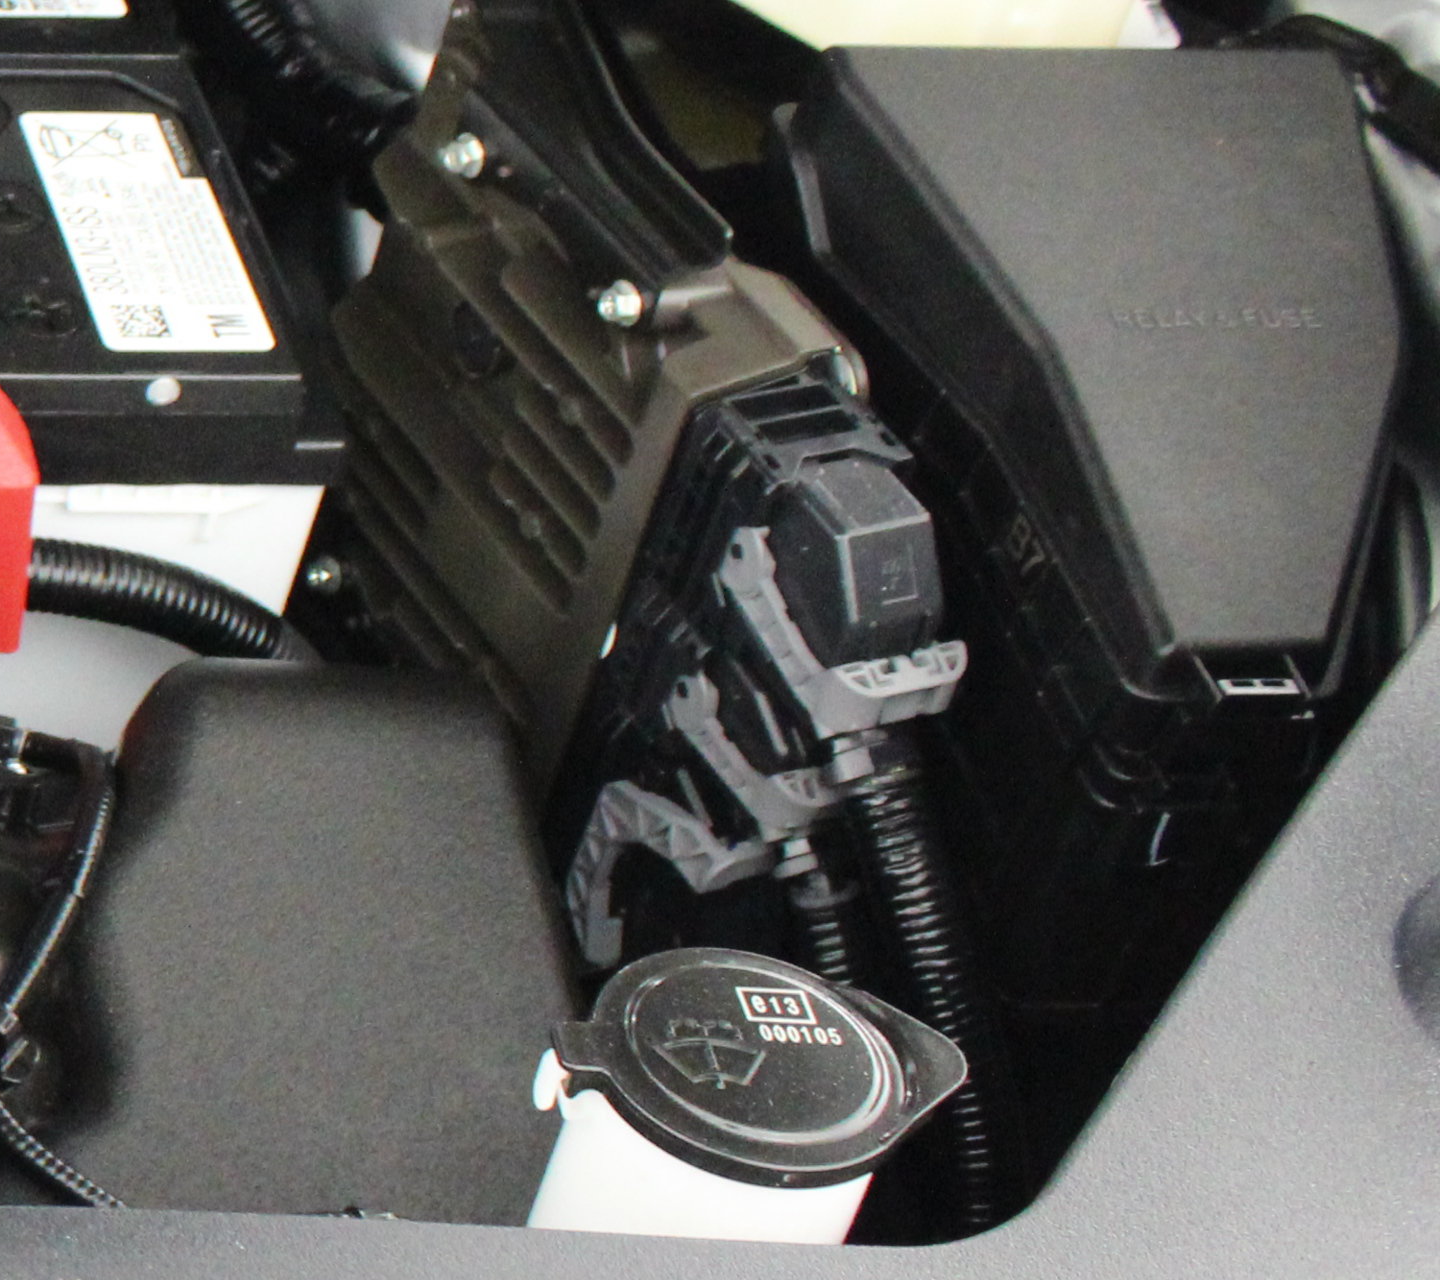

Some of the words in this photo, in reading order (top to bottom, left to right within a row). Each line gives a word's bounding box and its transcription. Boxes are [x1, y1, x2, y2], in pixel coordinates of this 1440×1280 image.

[1242, 307, 1323, 329] FUSE
[749, 993, 802, 1017] e13
[759, 1022, 843, 1048] 000105
